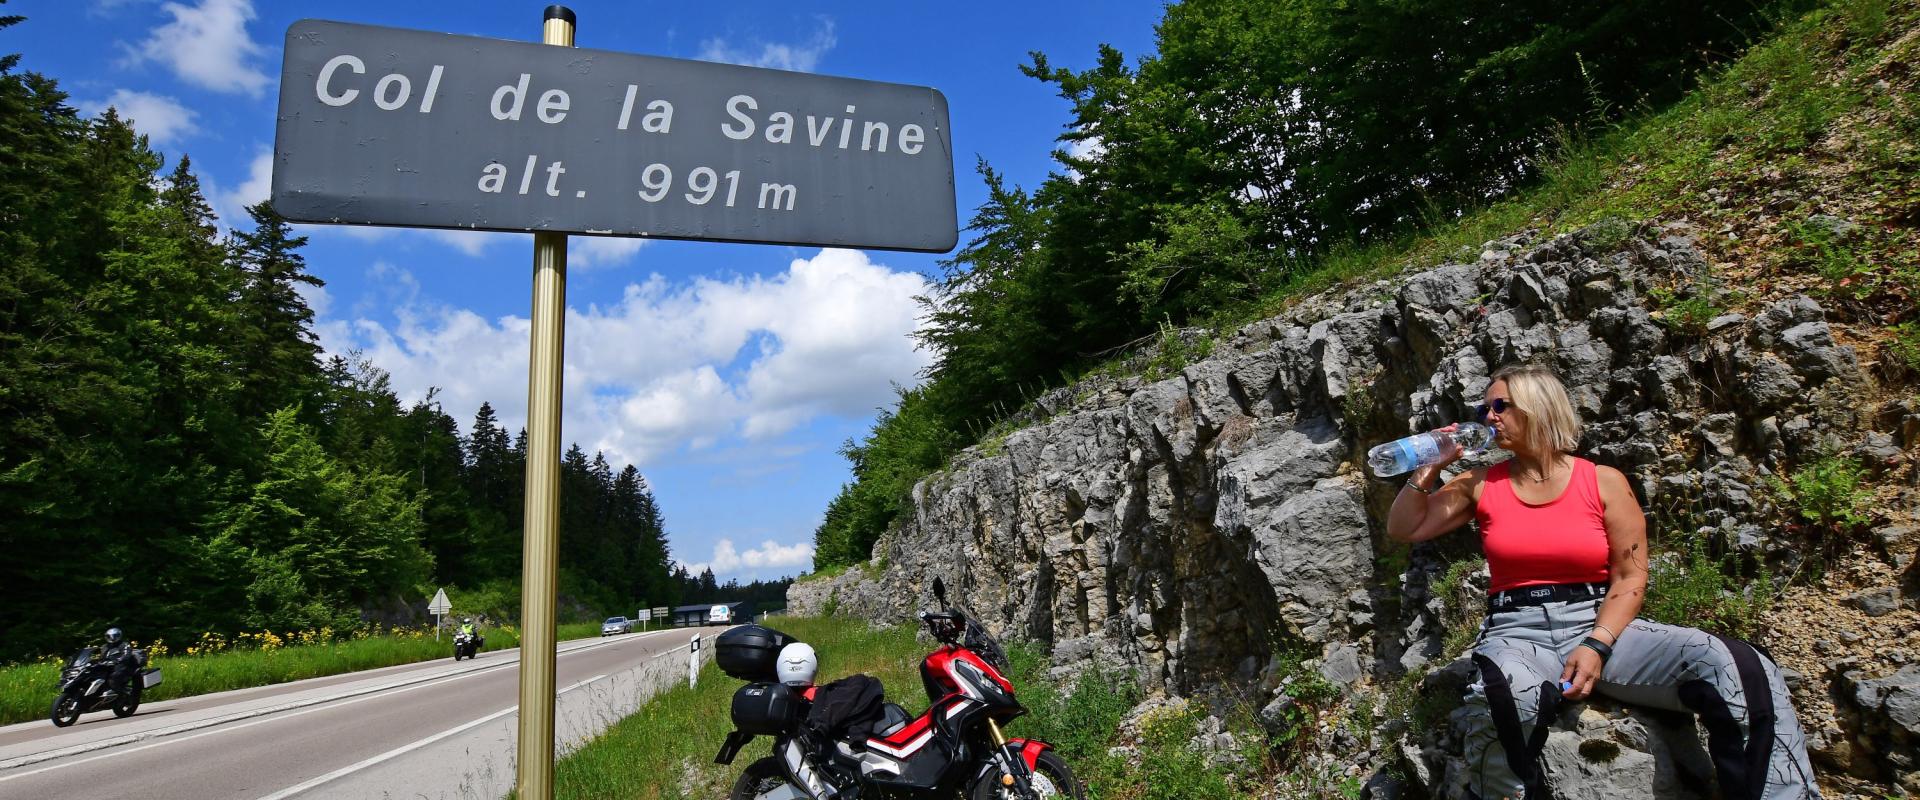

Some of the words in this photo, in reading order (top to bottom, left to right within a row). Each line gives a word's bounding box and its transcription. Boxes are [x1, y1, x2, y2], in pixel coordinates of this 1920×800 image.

[315, 54, 445, 113] Col
[490, 73, 571, 124] de
[617, 84, 674, 134] la
[721, 94, 925, 155] Savine
[477, 154, 586, 198] alt.
